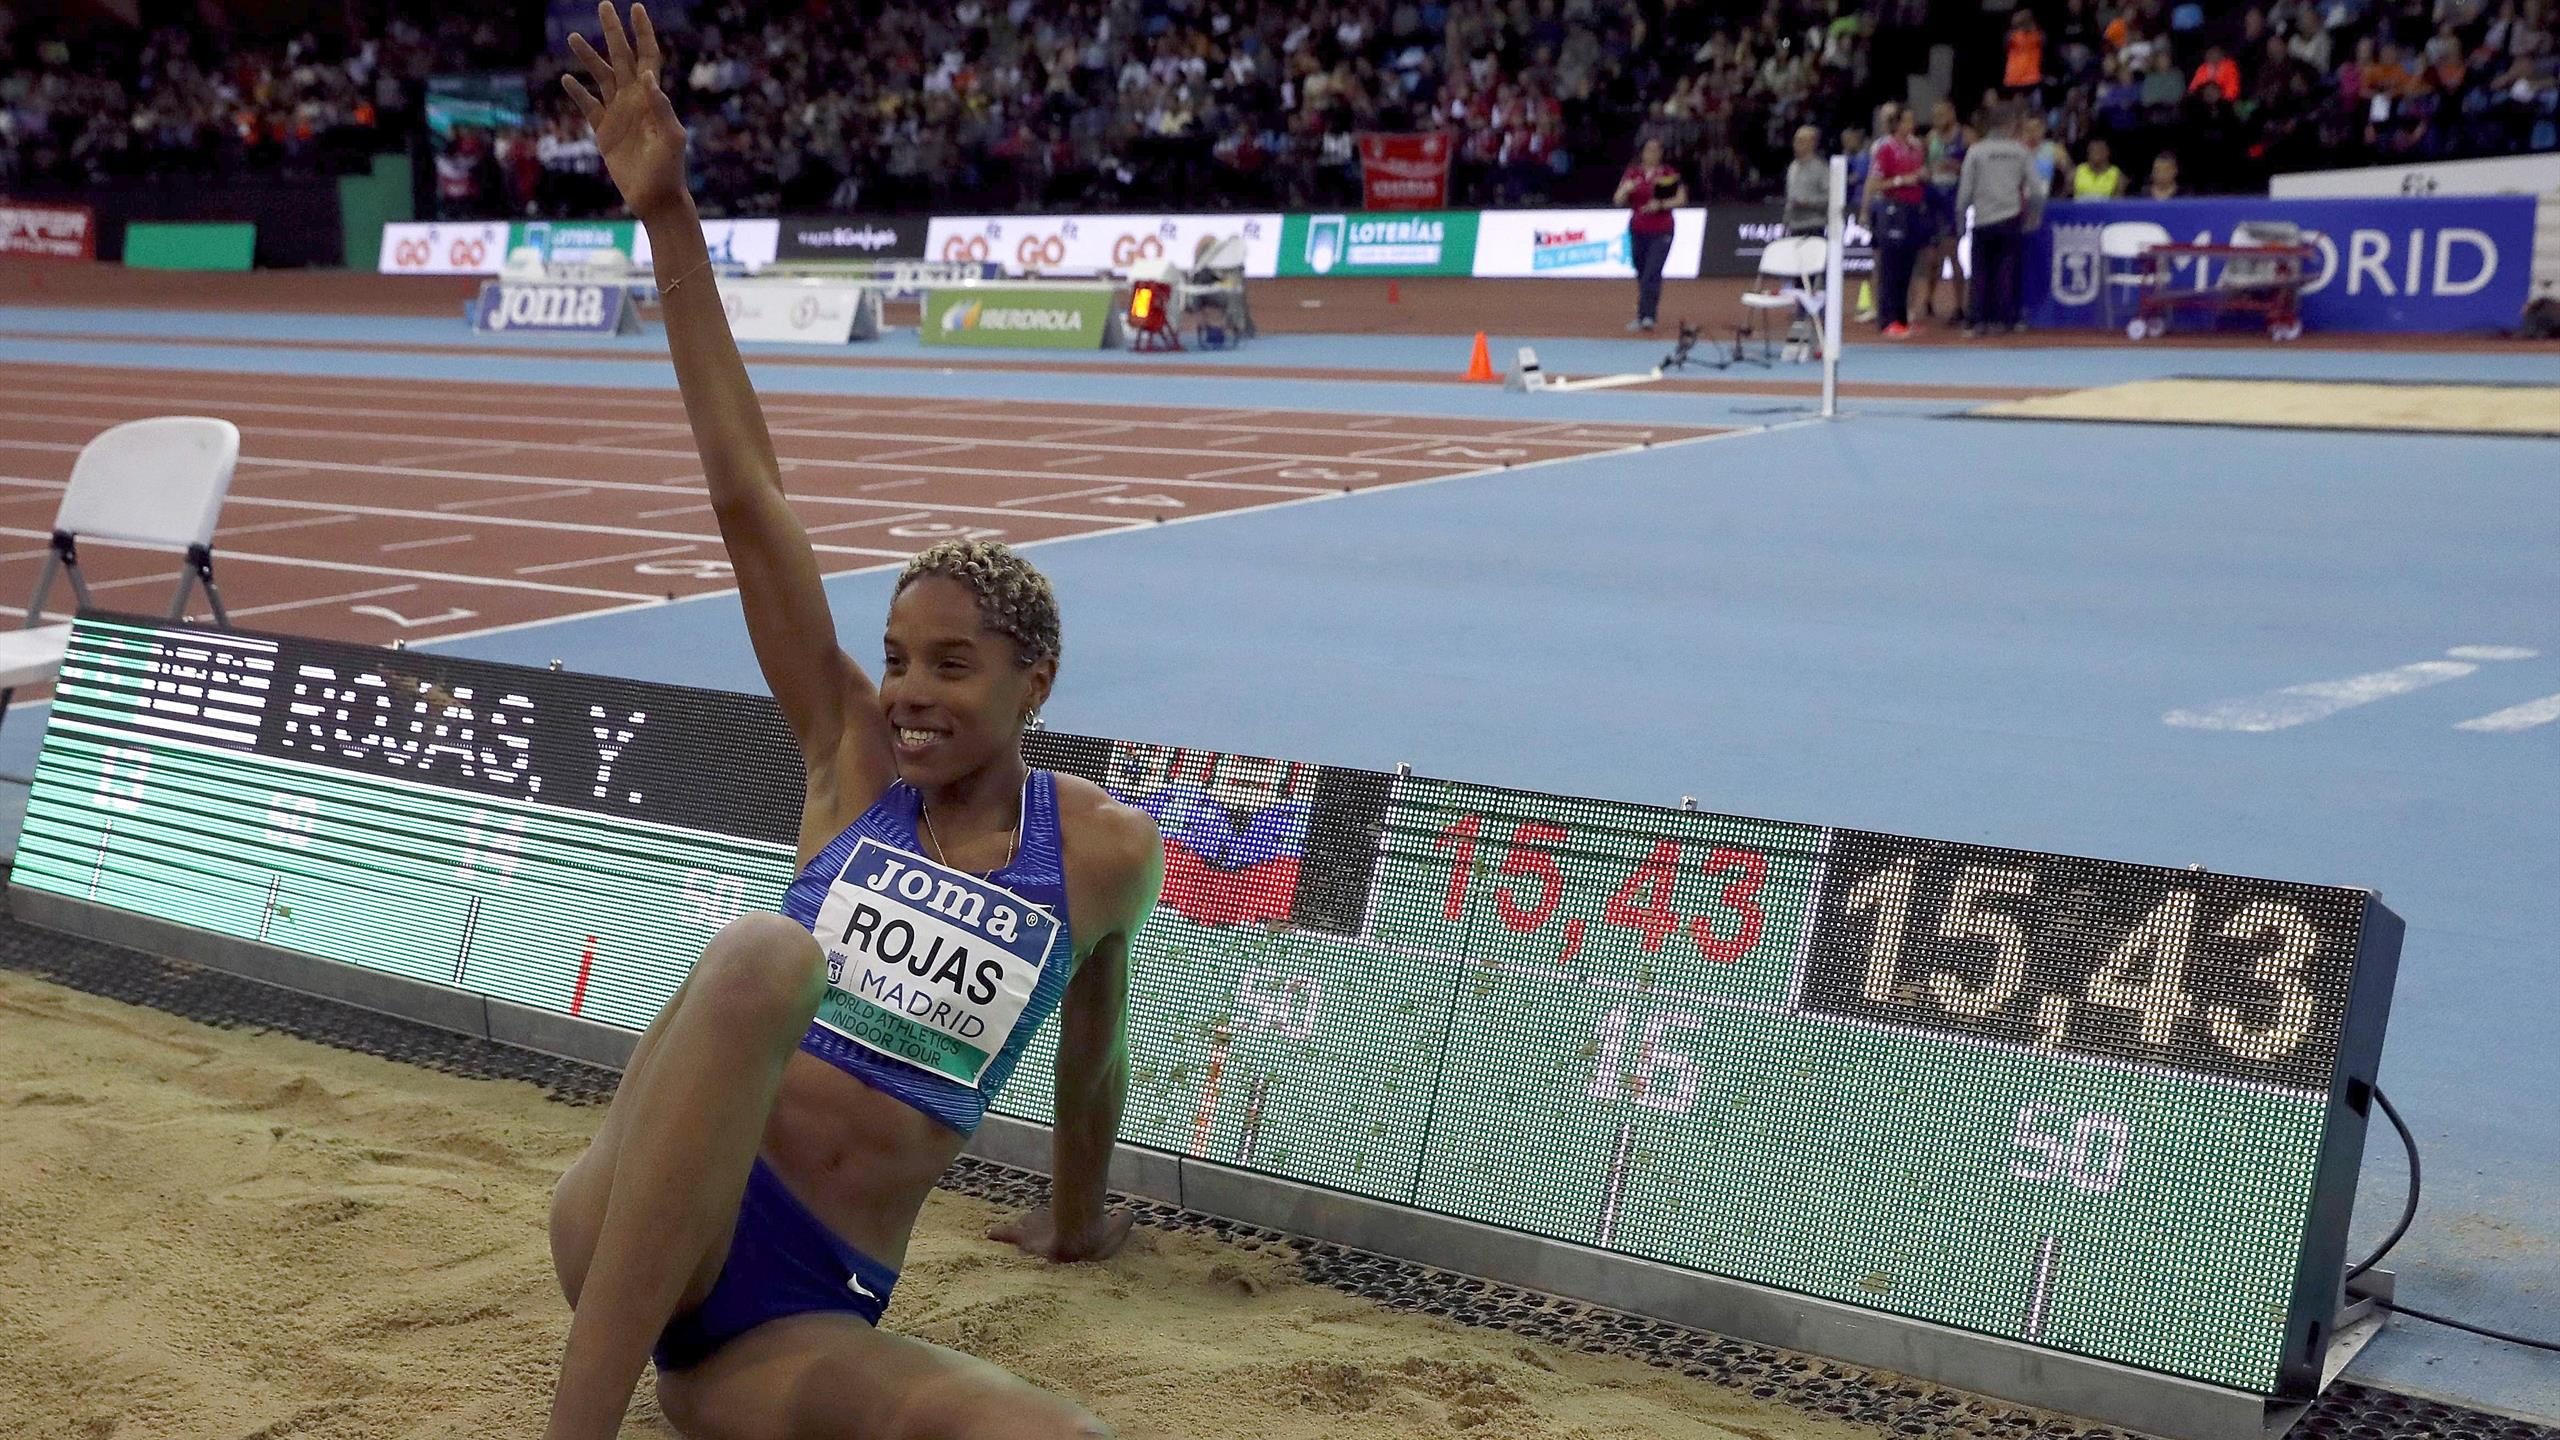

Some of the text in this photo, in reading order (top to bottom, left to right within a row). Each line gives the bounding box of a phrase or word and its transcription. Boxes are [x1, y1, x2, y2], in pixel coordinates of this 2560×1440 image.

[1348, 216, 1444, 242] LOTERÍAS
[395, 238, 431, 268] GO
[449, 238, 485, 268] GO
[1017, 234, 1065, 268] GO
[1113, 234, 1164, 269] GO
[979, 309, 1082, 332] IBERDROLA
[1434, 813, 1769, 965] 15,43
[841, 902, 1005, 1006] ROJAS
[1846, 854, 2318, 1062] 15,43
[860, 968, 985, 1039] MADRID
[831, 1008, 942, 1066] INDOOR TOUR
[875, 1012, 962, 1055] ATHLETICS
[1586, 1001, 1701, 1113] 16
